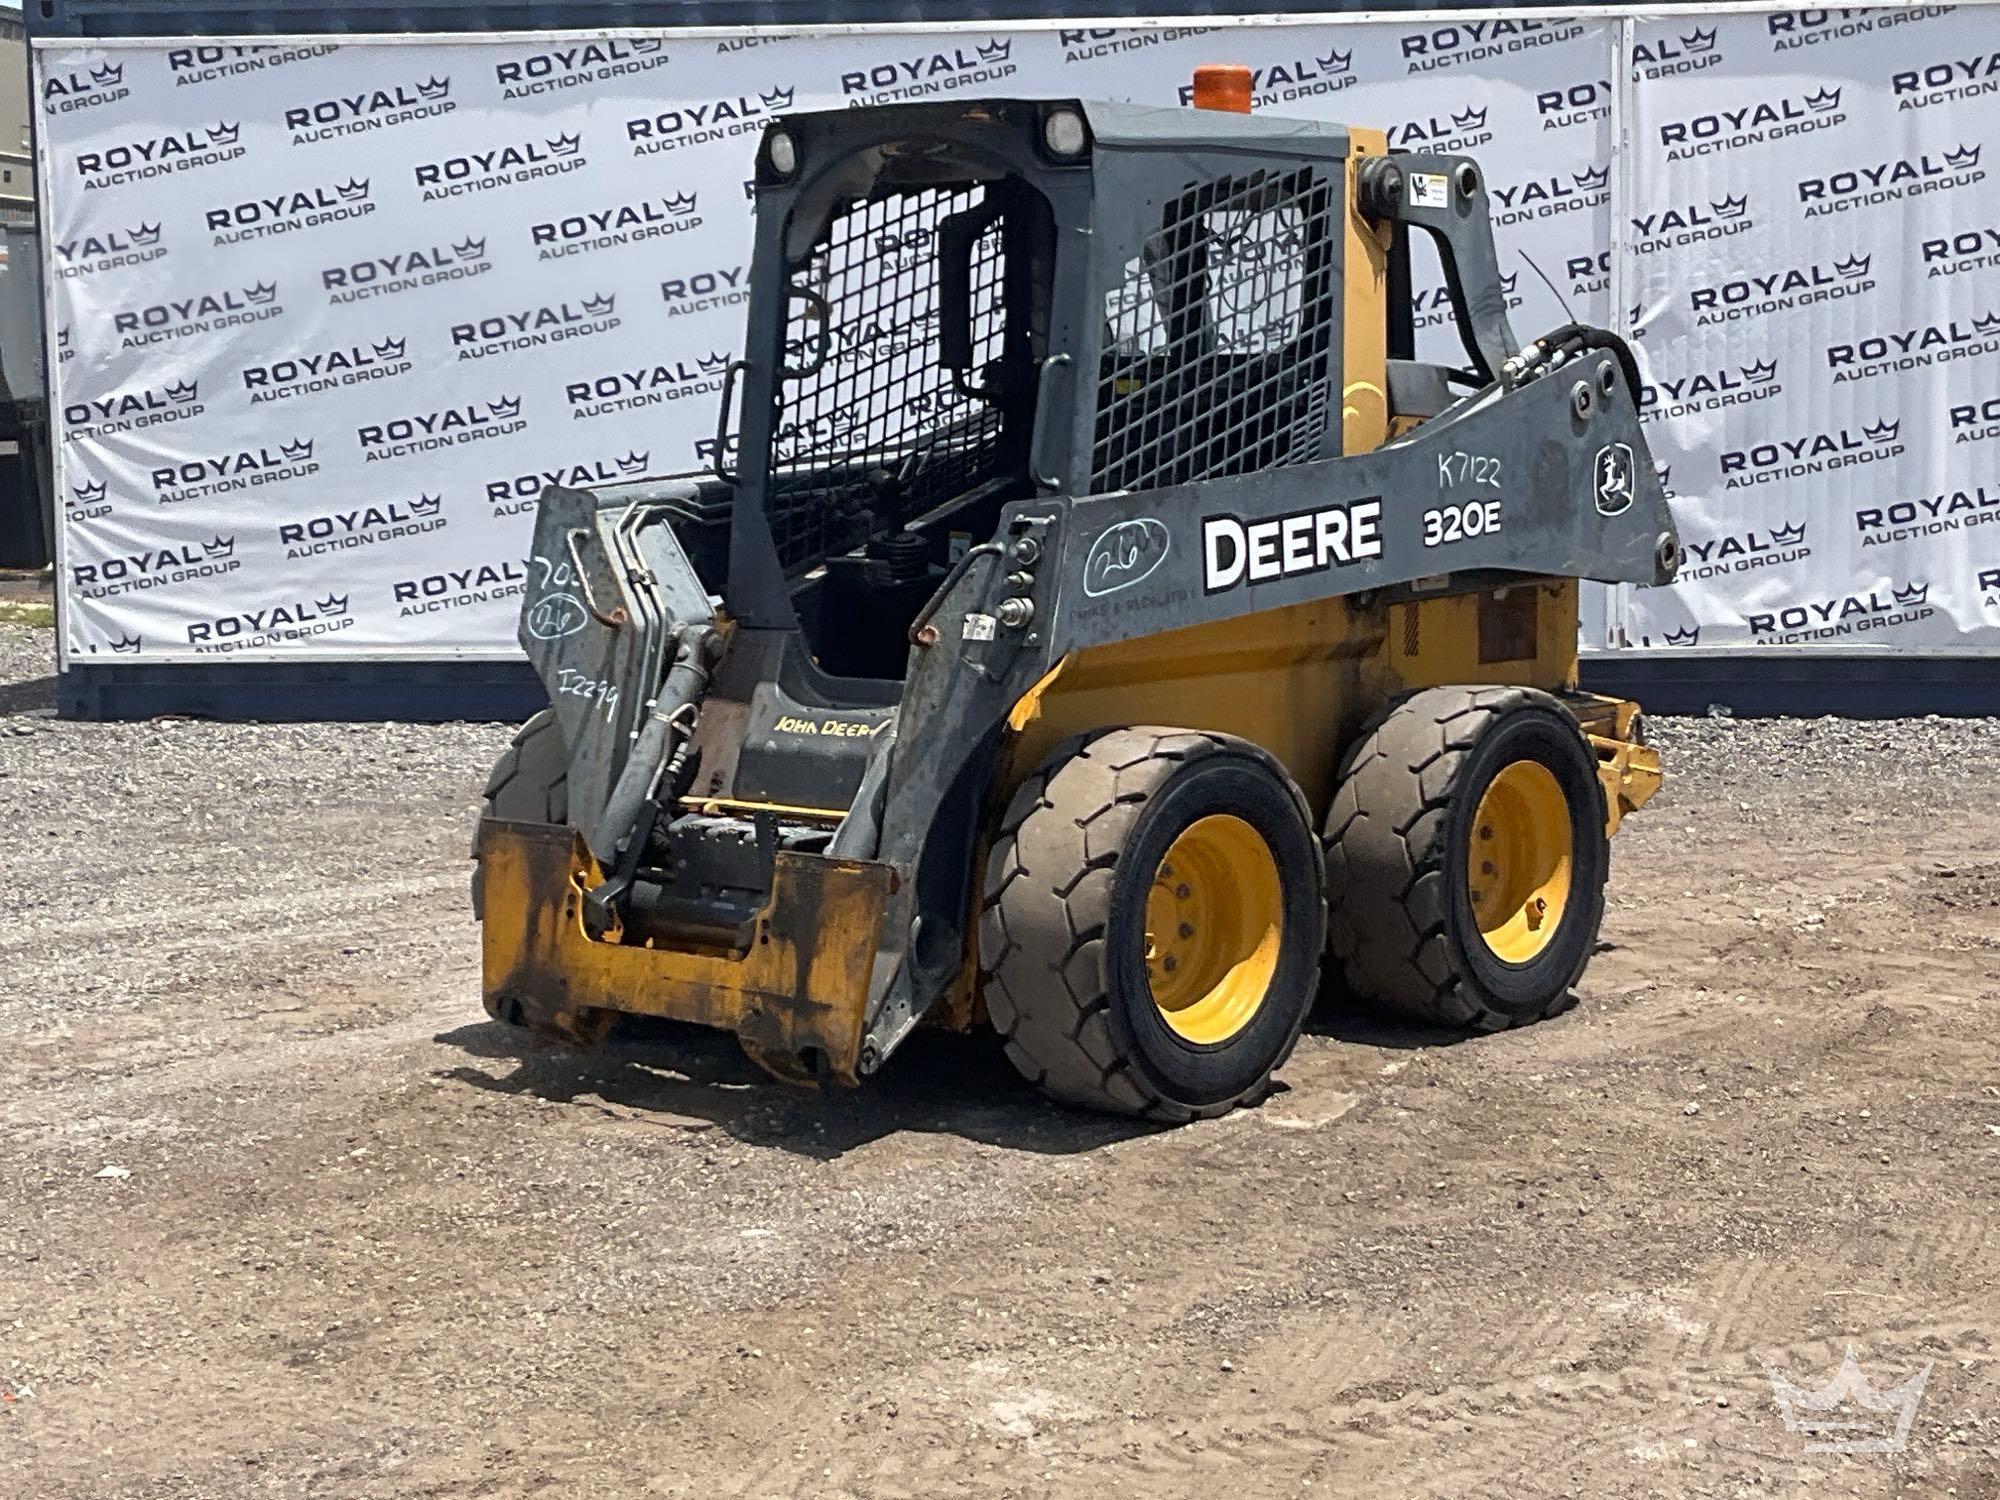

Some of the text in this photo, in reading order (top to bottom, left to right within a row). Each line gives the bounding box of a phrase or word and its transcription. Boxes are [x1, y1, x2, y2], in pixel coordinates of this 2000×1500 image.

[1066, 33, 1158, 63] AUCTION
[1401, 20, 1543, 58] ROYAL
[1408, 26, 1584, 74] AUCTION GROUP
[1774, 20, 1872, 52] AUCTION
[177, 58, 265, 86] AUCTION
[496, 39, 630, 85] ROYAL
[503, 56, 668, 100] AUCTION GROUP
[842, 50, 977, 94] ROYAL
[1646, 54, 1722, 79] GROUP
[60, 88, 130, 112] GROUP
[850, 65, 1016, 109] AUCTION GROUP
[1283, 76, 1357, 100] GROUP
[1899, 81, 1998, 111] AUCTION
[285, 87, 418, 130] ROYAL
[293, 102, 456, 146] AUCTION GROUP
[627, 97, 760, 140] ROYAL
[1544, 107, 1611, 131] AUCTI
[1661, 100, 1804, 146] ROYAL
[77, 132, 207, 175] ROYAL
[635, 129, 723, 156] AUCTION
[1667, 114, 1846, 162] AUCTION GROUP
[85, 147, 245, 190] AUCTION GROUP
[416, 144, 547, 186] ROYAL
[424, 158, 586, 202] AUCTION GROUP
[1799, 156, 1943, 202] ROYAL
[206, 189, 337, 231] ROYAL
[1492, 178, 1573, 209] YAL
[1805, 171, 1985, 218] AUCTION GROUP
[215, 203, 375, 246] AUCTION GROUP
[532, 203, 664, 245] ROYAL
[540, 218, 702, 260] AUCTION GROUP
[1631, 206, 1711, 237] YAL
[1677, 220, 1752, 245] GROUP
[56, 234, 129, 261] YAL
[99, 248, 167, 270] GROUP
[1928, 253, 2000, 278] AUCTI
[322, 248, 453, 289] ROYAL
[331, 263, 491, 304] AUCTION GROUP
[662, 267, 741, 301] ROY
[1691, 266, 1834, 311] ROYAL
[115, 292, 244, 333] ROYAL
[1697, 280, 1875, 326] AUCTION GROUP
[122, 307, 282, 348] AUCTION GROUP
[451, 304, 582, 345] ROYAL
[459, 319, 620, 361] AUCTION GROUP
[1828, 322, 1971, 367] ROYAL
[243, 348, 374, 389] ROYAL
[1833, 340, 1999, 384] AUCTION GROU
[251, 362, 412, 404] AUCTION GROUP
[566, 363, 698, 404] ROYAL
[574, 380, 722, 419] AUCTION GROU
[1640, 371, 1741, 406] OYAL
[64, 405, 204, 443] CTION GROUP
[65, 391, 167, 425] OYAL
[1639, 385, 1781, 424] CTION GROUP
[358, 406, 489, 447] ROYAL
[366, 421, 526, 462] AUCTION GROUP
[152, 449, 281, 489] ROYAL
[1720, 430, 1863, 474] ROYAL
[1726, 445, 1905, 489] AUCTION GROUP
[159, 463, 319, 504] AUCTION GROUP
[487, 462, 617, 502] ROYAL
[280, 505, 410, 544] ROYAL
[1424, 501, 1501, 547] 320E
[1856, 488, 2000, 531] ROYAL
[288, 519, 446, 559] AUCTION GROUP
[1204, 501, 1381, 589] DEERE
[1680, 533, 1770, 565] YAL
[1862, 519, 1959, 547] AUCTION
[73, 546, 203, 586] ROYAL
[81, 561, 240, 598] AUCTION GROUP
[1735, 548, 1811, 571] GROUP
[394, 563, 522, 602] ROYAL
[188, 604, 316, 644] ROYAL
[401, 592, 487, 617] AUCTION
[1749, 593, 1892, 635] ROYAL
[1856, 608, 1934, 631] GROUP
[285, 619, 353, 639] GROUP
[774, 716, 817, 735] JOHN
